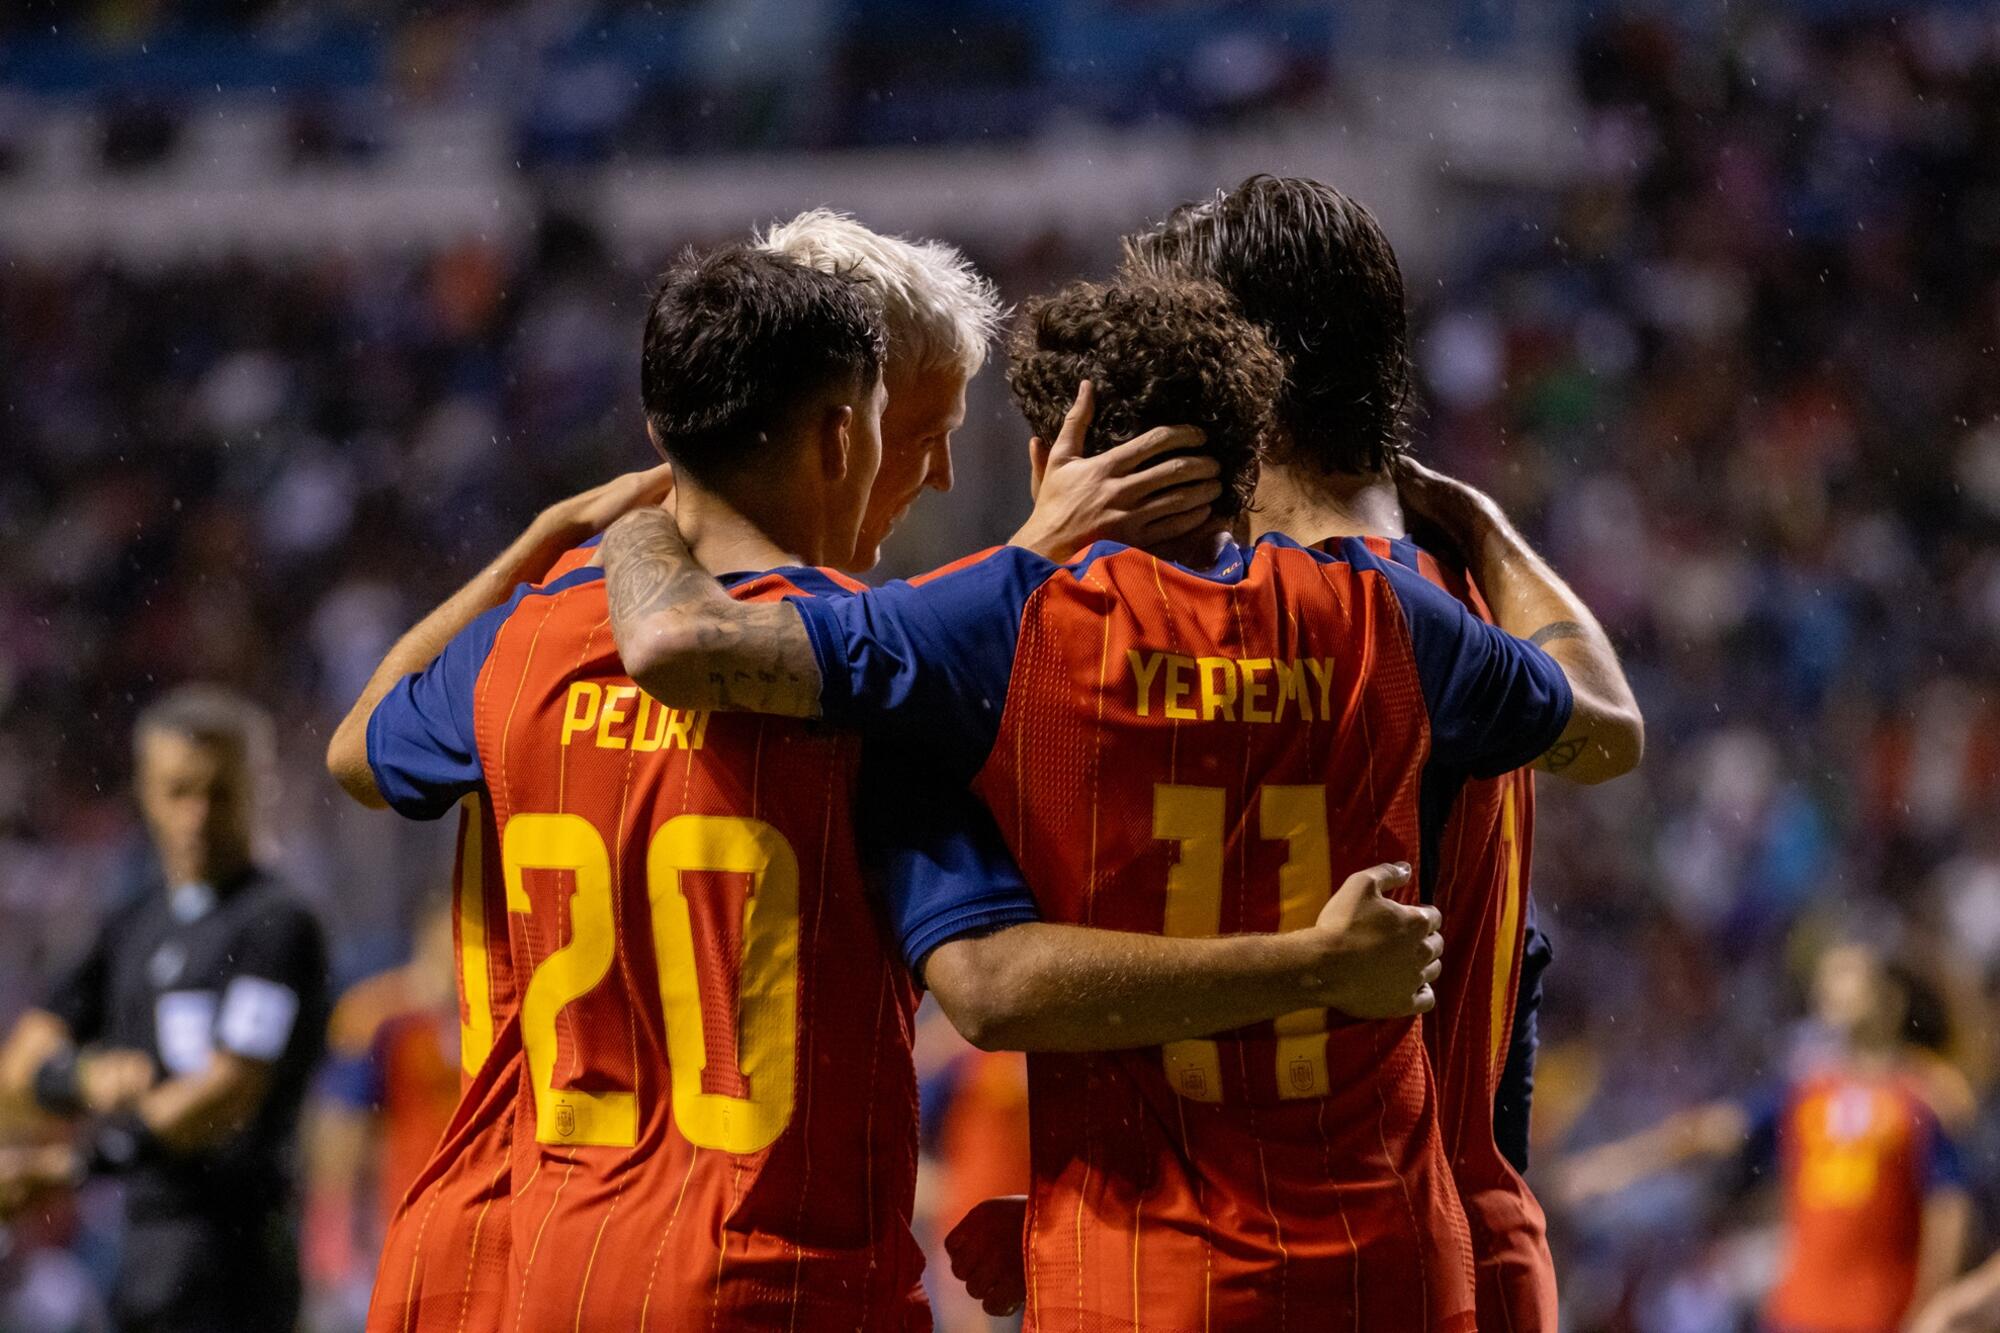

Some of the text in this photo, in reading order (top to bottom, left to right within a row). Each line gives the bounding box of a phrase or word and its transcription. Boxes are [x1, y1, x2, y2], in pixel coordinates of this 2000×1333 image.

[1128, 650, 1335, 723] YEREMY
[503, 813, 800, 1154] 20
[1153, 784, 1332, 1101] 11
